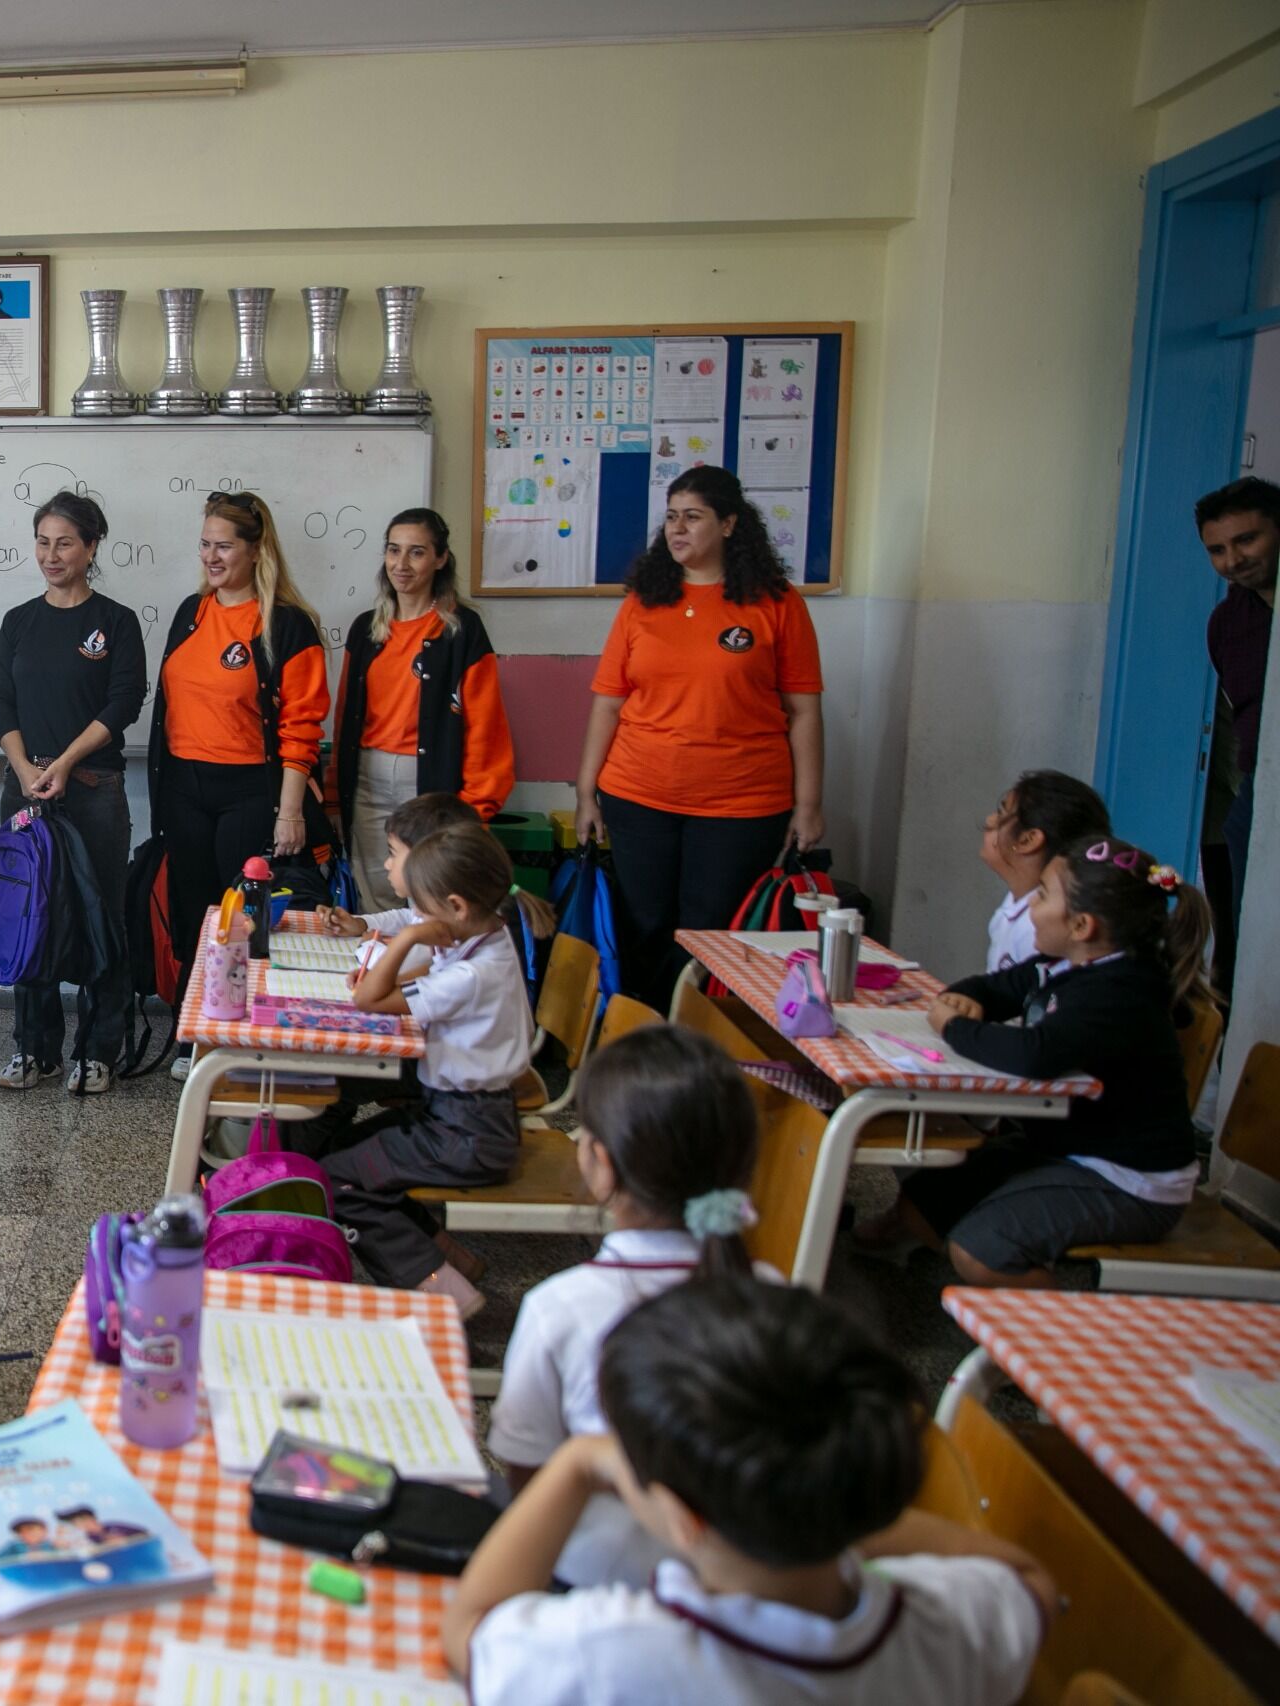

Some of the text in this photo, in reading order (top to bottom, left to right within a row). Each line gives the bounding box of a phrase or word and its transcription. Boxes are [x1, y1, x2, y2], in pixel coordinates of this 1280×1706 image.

[531, 345, 613, 355] ALFABE TABLOSU
[111, 541, 155, 568] an
